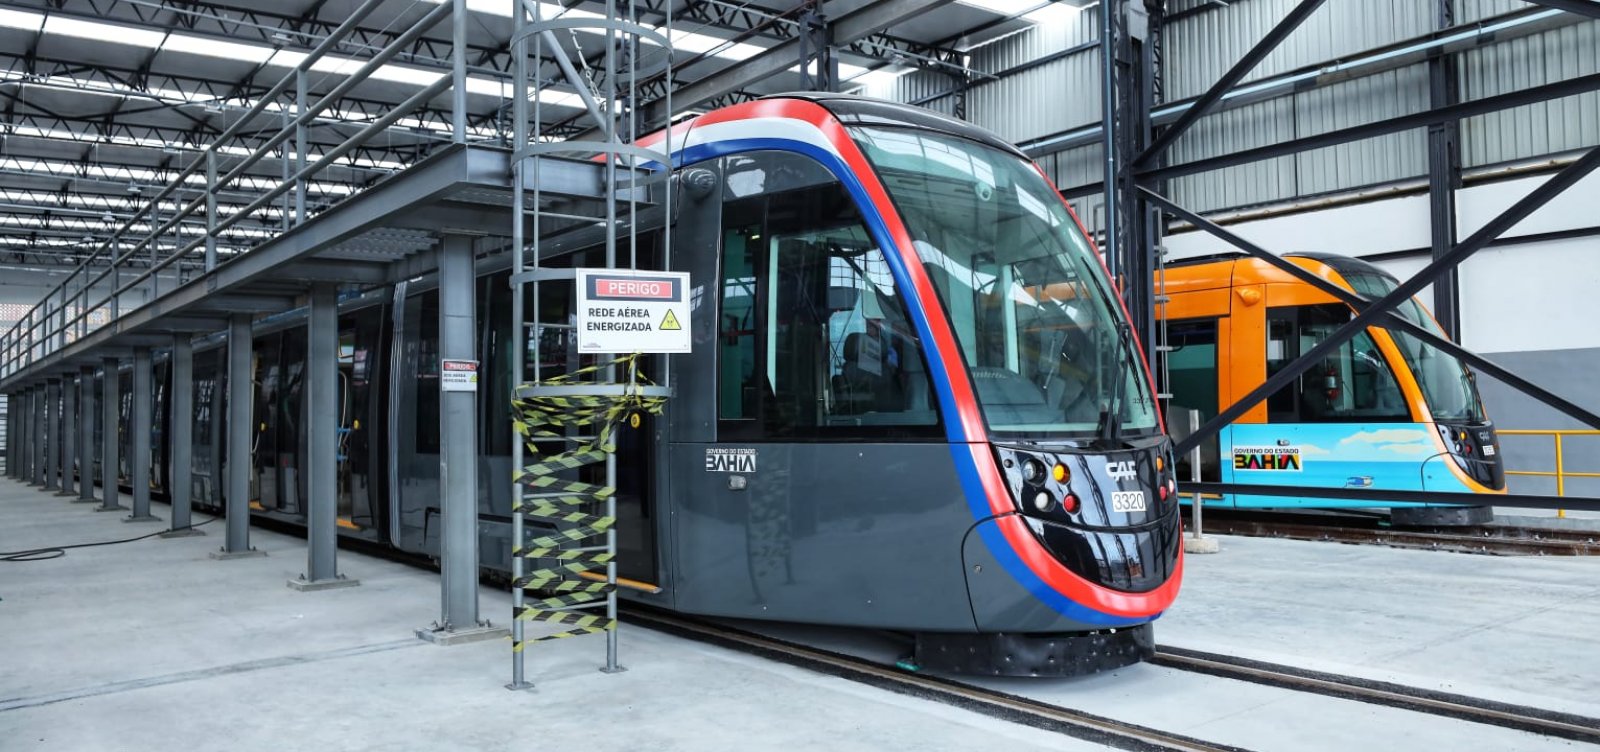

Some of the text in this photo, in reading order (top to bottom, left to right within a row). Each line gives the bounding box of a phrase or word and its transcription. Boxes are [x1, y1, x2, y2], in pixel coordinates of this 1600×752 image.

[608, 282, 660, 295] PERIGO
[588, 306, 650, 318] REDE AÉREA
[587, 322, 652, 332] ENERGIZADA
[706, 454, 756, 472] BAHIA
[1235, 454, 1300, 470] BAHIA
[1113, 493, 1144, 510] 3320
